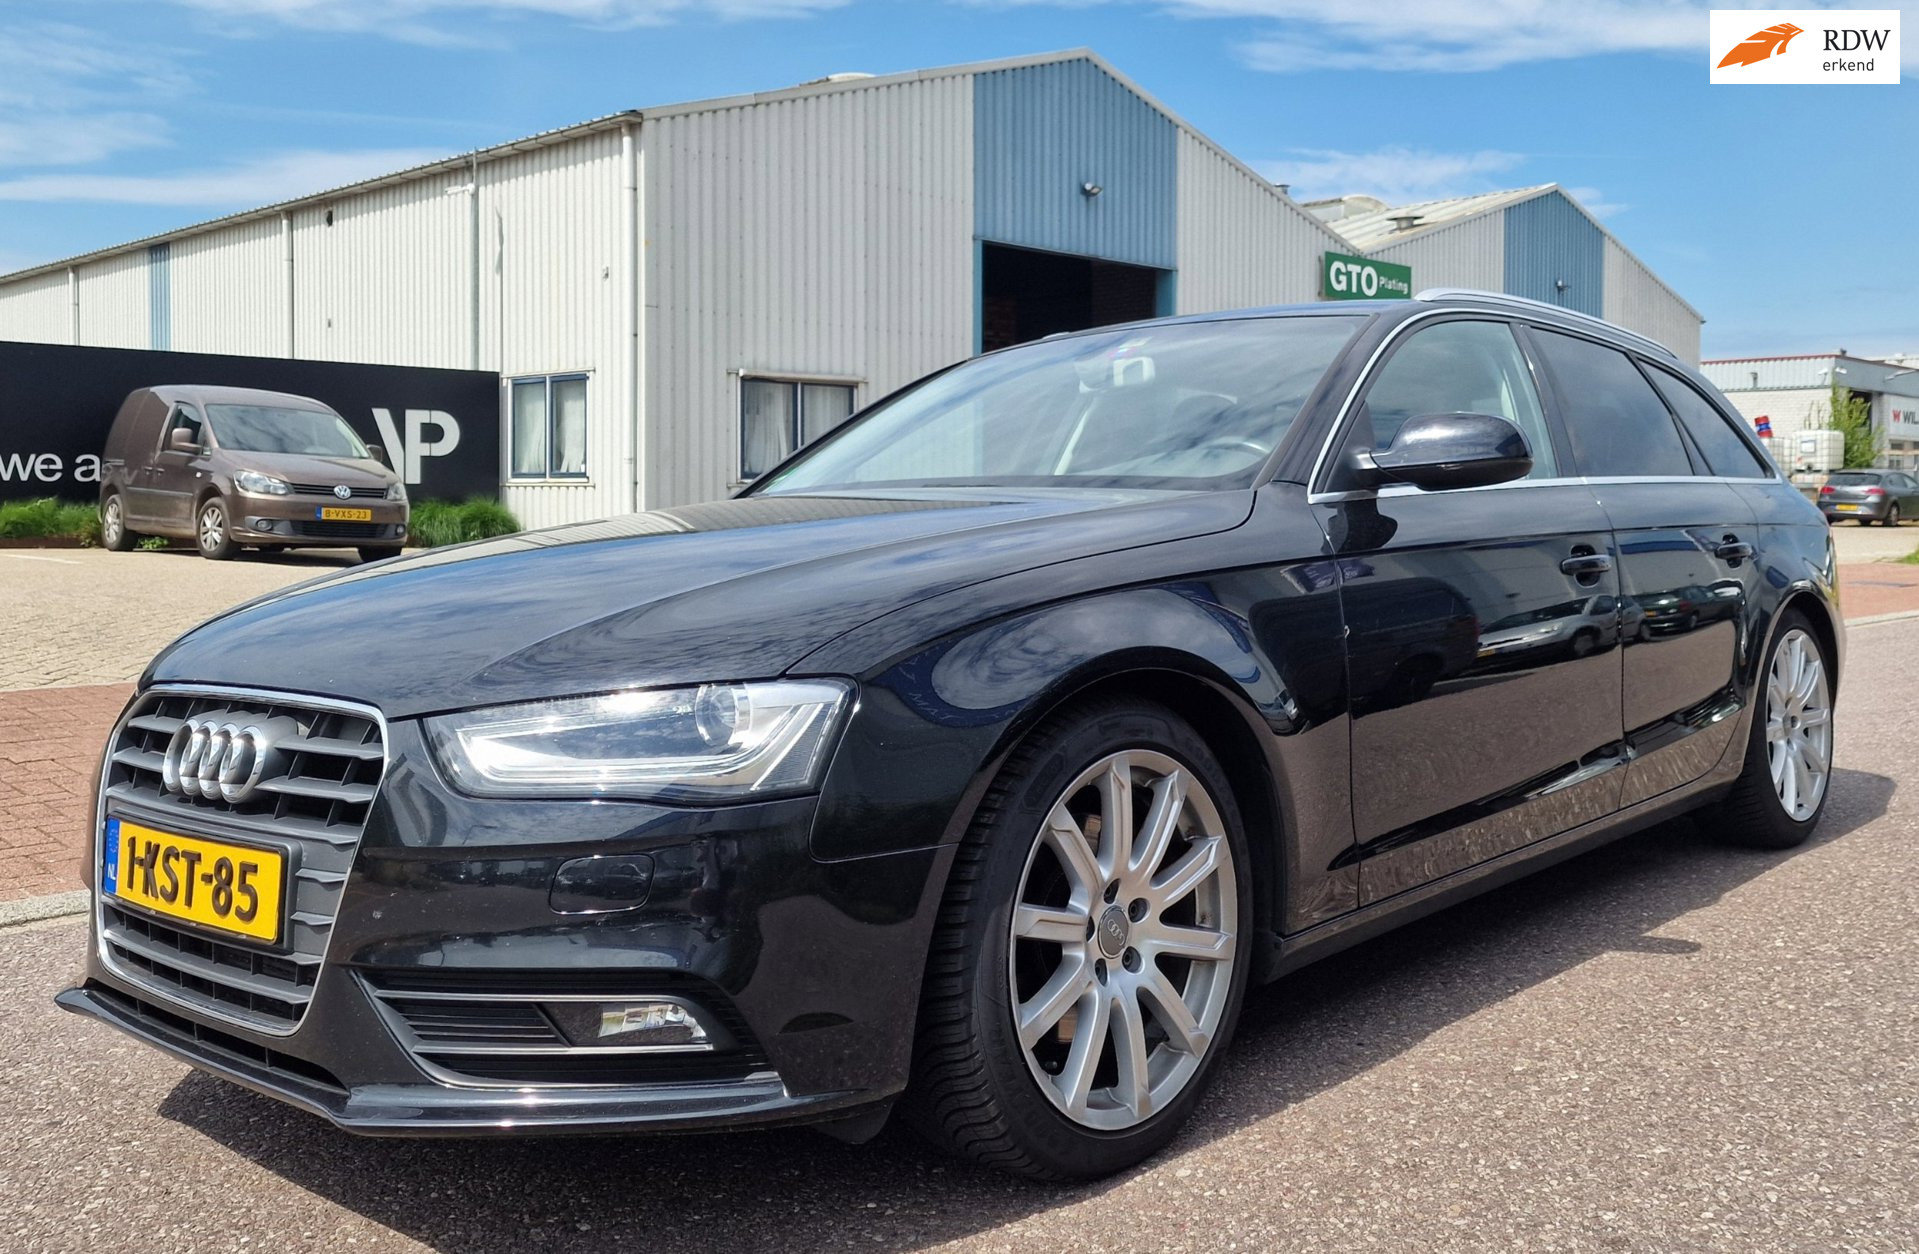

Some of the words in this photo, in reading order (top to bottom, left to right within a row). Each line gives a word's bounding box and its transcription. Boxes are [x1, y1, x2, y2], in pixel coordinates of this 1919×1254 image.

[1329, 260, 1378, 297] GTO
[1379, 276, 1409, 295] Plating
[0, 452, 63, 482] we
[126, 835, 259, 923] 1-KST-85
